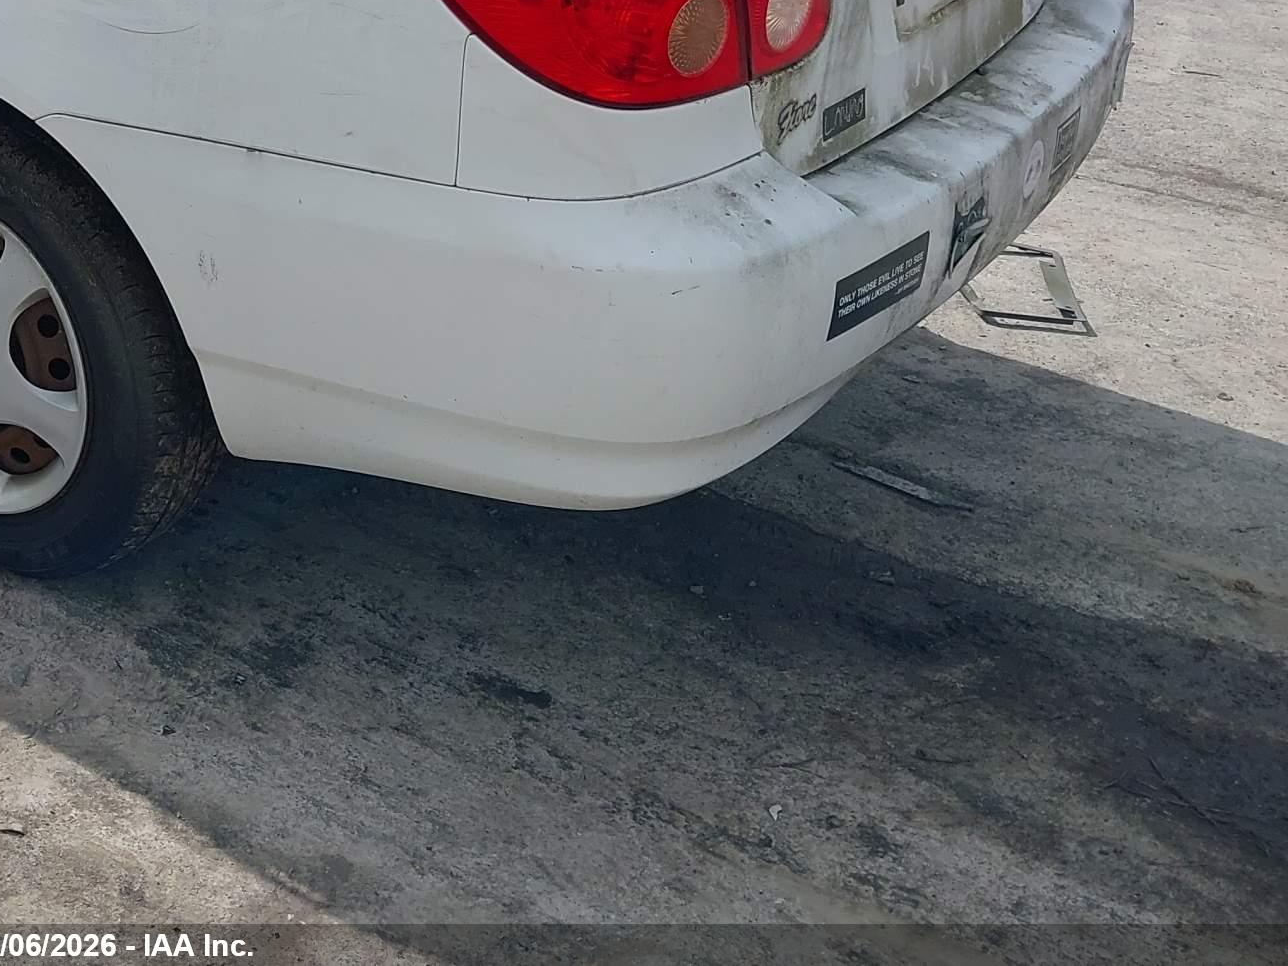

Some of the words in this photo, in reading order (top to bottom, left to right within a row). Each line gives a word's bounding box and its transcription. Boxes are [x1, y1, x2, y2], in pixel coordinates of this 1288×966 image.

[838, 302, 856, 318] THEIR
[856, 294, 871, 308] OWN
[871, 278, 898, 300] LIKENESS
[898, 275, 905, 284] IN
[905, 263, 923, 280] STONE
[839, 290, 856, 306] ONLY
[857, 278, 878, 296] THOSE
[878, 272, 891, 285] EVIL
[891, 263, 904, 277] LIVE
[905, 258, 913, 269] TO
[913, 251, 925, 264] SEE
